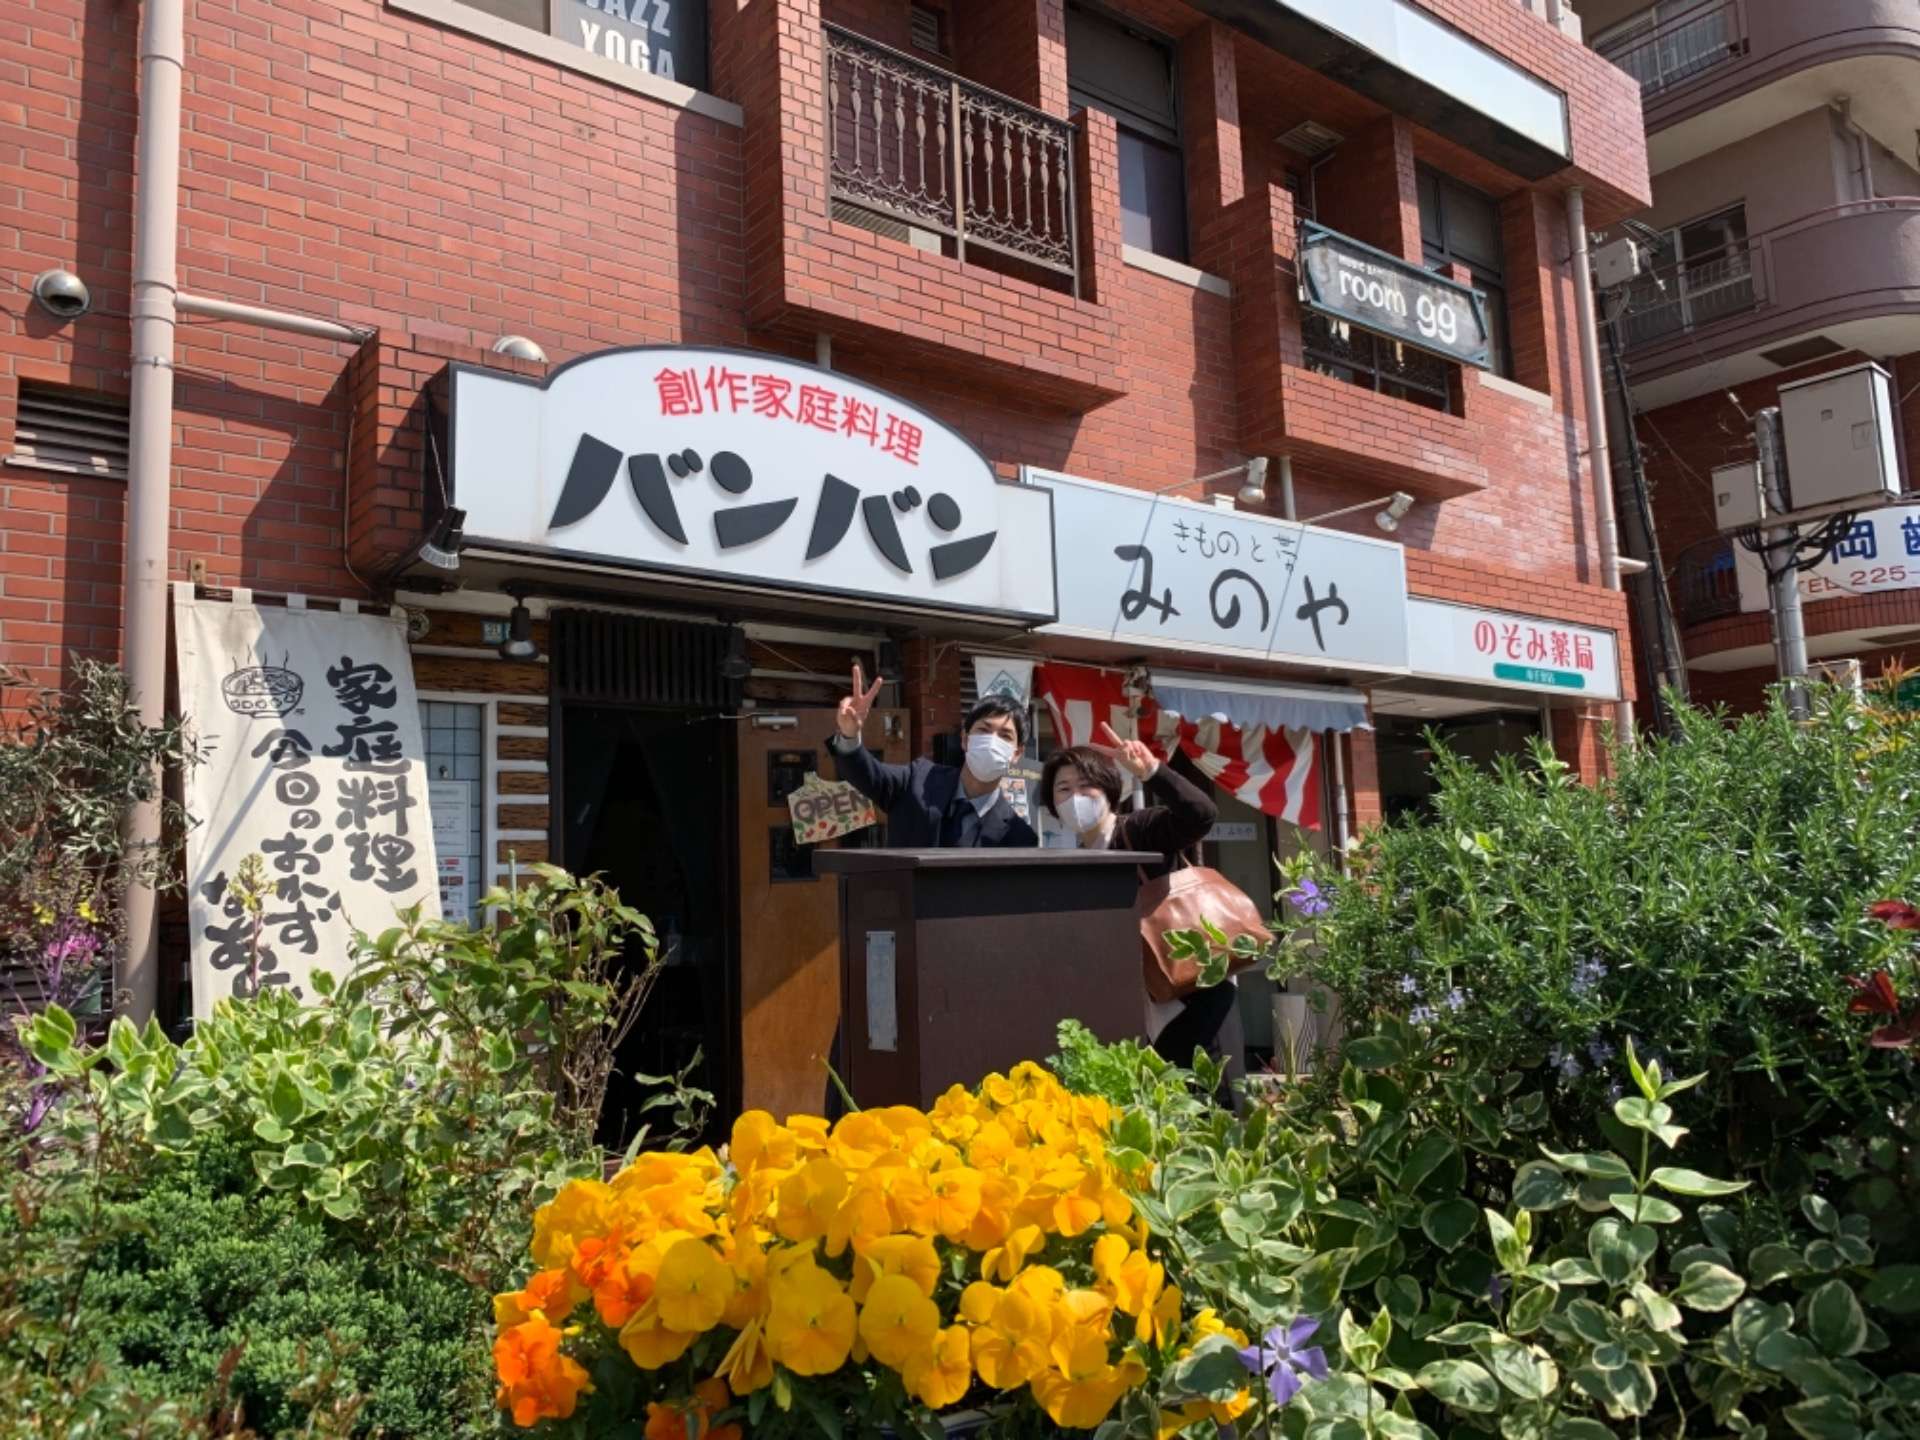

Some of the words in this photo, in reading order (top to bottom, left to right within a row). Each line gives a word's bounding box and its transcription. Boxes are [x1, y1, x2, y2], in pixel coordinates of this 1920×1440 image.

[586, 0, 671, 37] AZZ
[580, 18, 675, 81] YOGA
[1339, 269, 1408, 317] room
[653, 366, 923, 467] 創作家庭料理
[548, 432, 998, 581] バンバン
[1113, 544, 1349, 652] みのや
[1799, 575, 1841, 594] EL
[1474, 620, 1594, 671] のぞみ薬局
[321, 655, 418, 893] 家庭料理
[794, 790, 871, 819] OPEN
